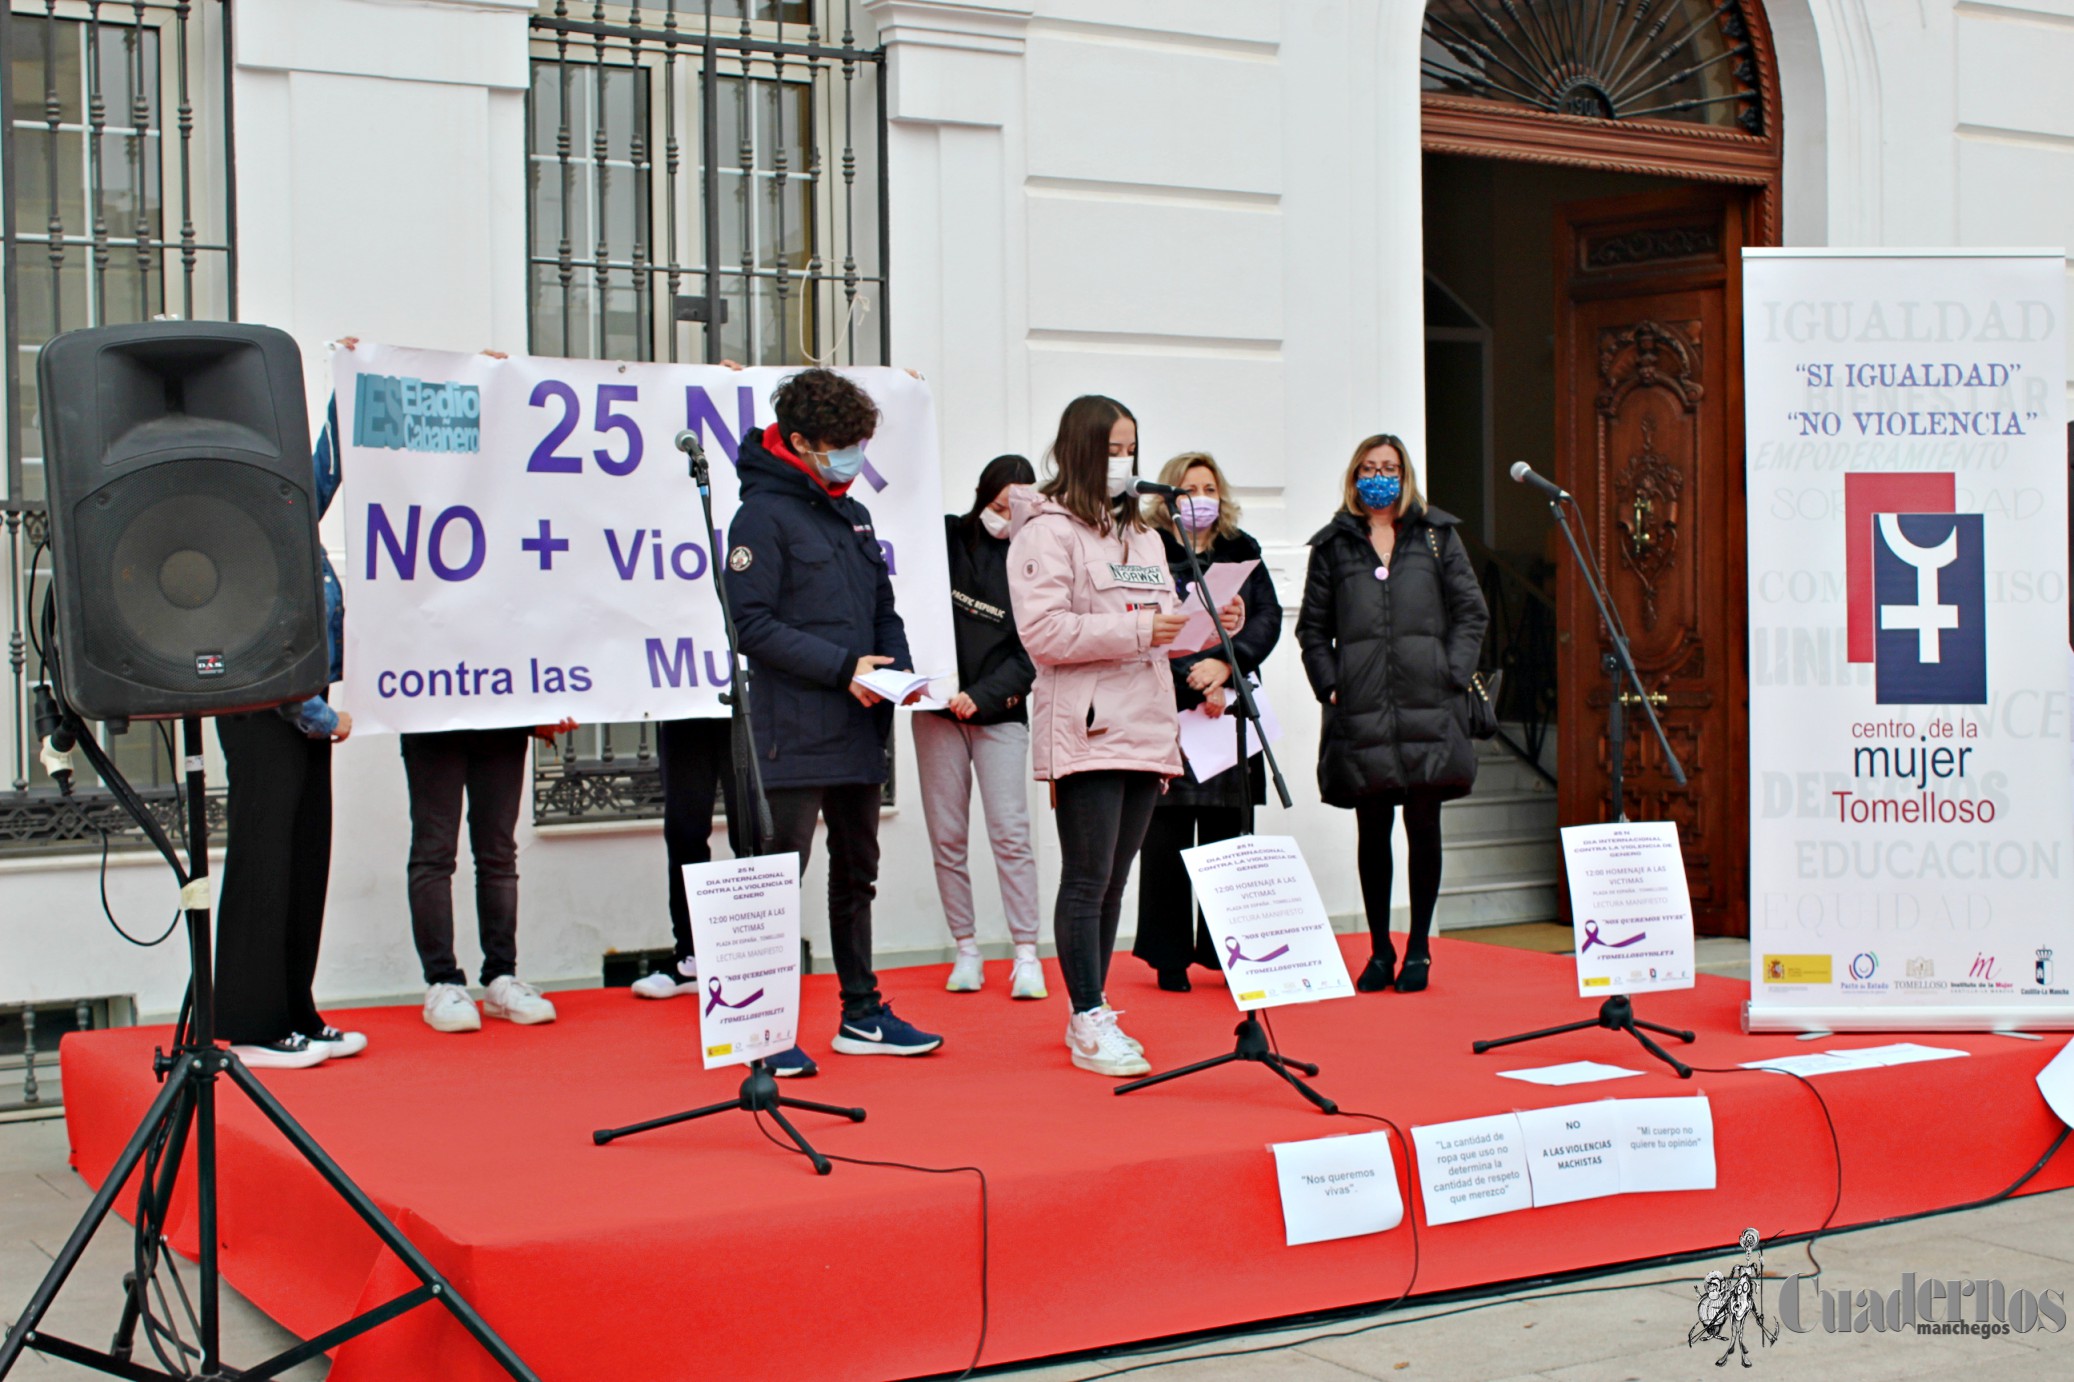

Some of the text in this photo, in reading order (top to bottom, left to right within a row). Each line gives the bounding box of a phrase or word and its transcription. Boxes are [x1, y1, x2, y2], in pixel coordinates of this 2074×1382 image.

[1762, 300, 2055, 343] IGUALDAD
[400, 376, 480, 418] Eladio
[353, 372, 404, 450] IES
[404, 415, 480, 454] Cabañero
[526, 380, 643, 476] 25
[1753, 440, 2010, 471] EMPODERAMIENTO
[366, 503, 486, 582] NO
[378, 658, 593, 698] contra las
[1852, 718, 1978, 738] centro de la
[1854, 736, 1972, 789] mujer
[1832, 791, 1995, 823] Tomelloso
[1795, 840, 2061, 880] EDUCACION
[723, 872, 784, 884] INTERNACIONAL
[697, 887, 731, 895] CONTRA
[745, 881, 783, 890] VIOLENCIA
[733, 892, 764, 900] GENERO
[709, 916, 727, 924] 12:00
[729, 910, 766, 921] HOMENAJE
[1763, 892, 1992, 938] EQUIDAD
[733, 923, 765, 933] VICTIMAS
[1894, 981, 1947, 989] TOMELLOSO
[1566, 1121, 1581, 1130] NO
[1653, 1127, 1681, 1137] cuerpo
[1683, 1126, 1693, 1134] no
[1454, 1134, 1491, 1147] cantidad
[1493, 1132, 1504, 1140] de
[1631, 1140, 1656, 1150] quiere
[1658, 1140, 1666, 1148] tu
[1437, 1146, 1508, 1164] ropa que uso no
[1543, 1140, 1612, 1157] A LAS VIOLENCIAS
[1449, 1160, 1502, 1176] determina la
[1558, 1156, 1602, 1170] MACHISTAS
[1328, 1169, 1375, 1183] queremos
[1434, 1171, 1520, 1192] cantidad de respeto
[1450, 1194, 1466, 1205] que
